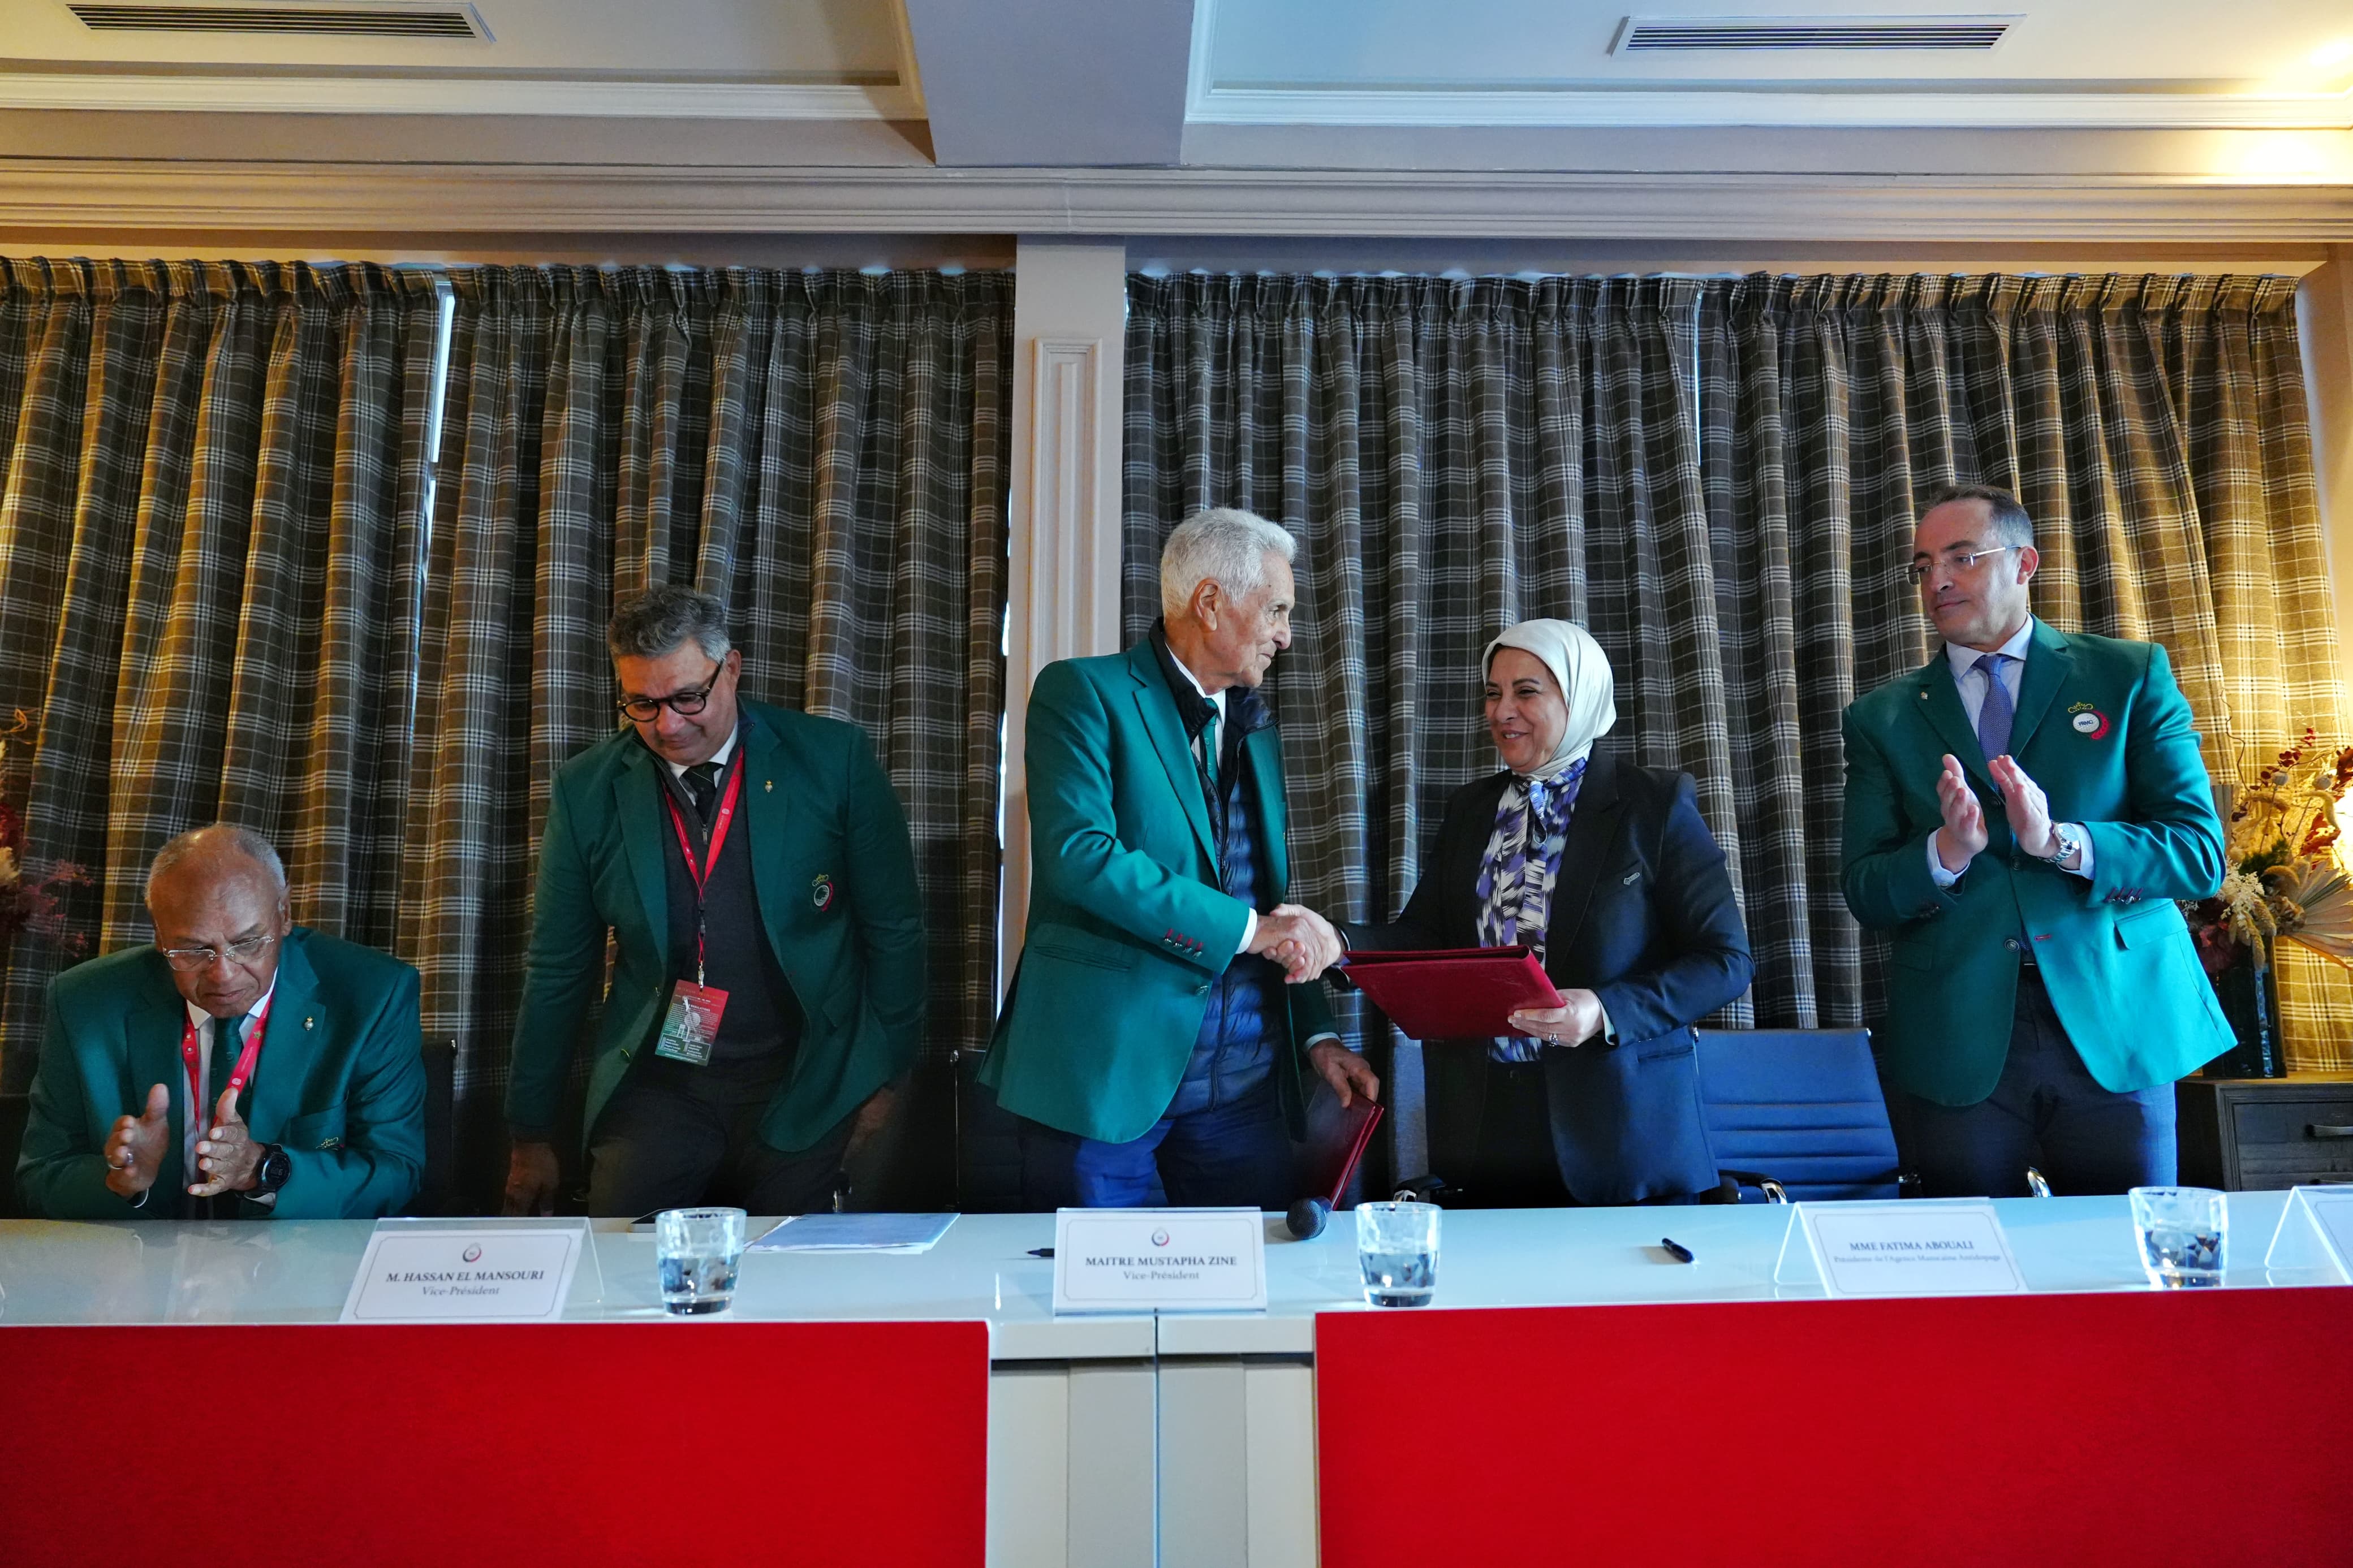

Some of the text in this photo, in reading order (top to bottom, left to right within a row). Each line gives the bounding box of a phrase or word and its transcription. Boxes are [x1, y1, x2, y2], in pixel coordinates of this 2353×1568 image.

[1850, 1241, 1975, 1251] MME FATIMA ABOUALI
[1085, 1255, 1237, 1266] MAITRE MUSTAPHA ZINE
[386, 1270, 544, 1282] M. HASSAN EL MANSOURI
[1123, 1270, 1200, 1280] Vice-Président
[423, 1285, 500, 1295] Vice-Président
